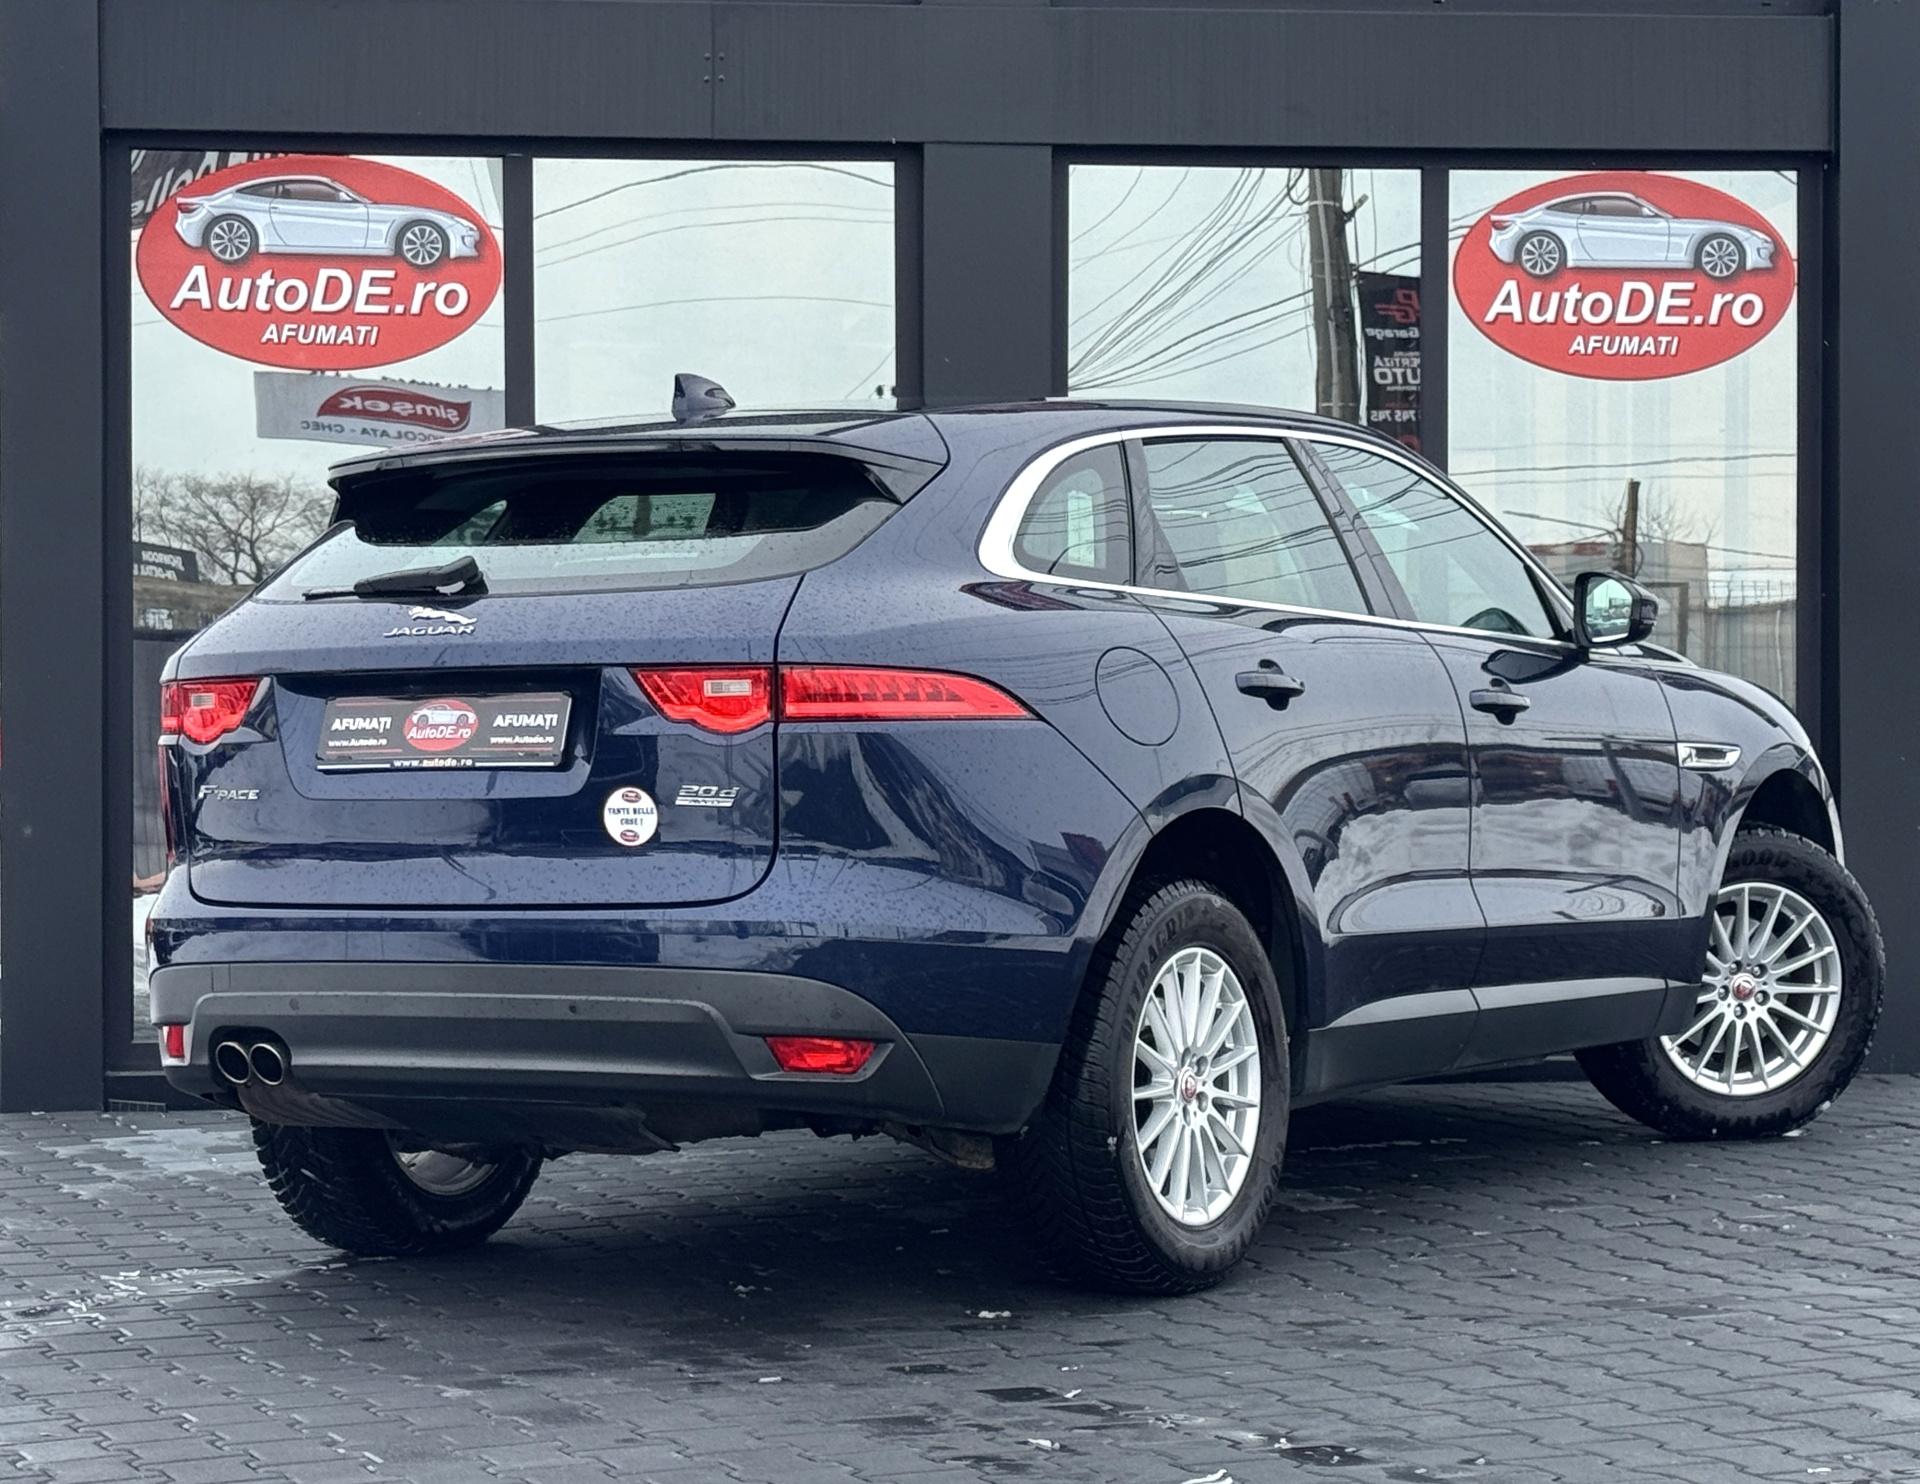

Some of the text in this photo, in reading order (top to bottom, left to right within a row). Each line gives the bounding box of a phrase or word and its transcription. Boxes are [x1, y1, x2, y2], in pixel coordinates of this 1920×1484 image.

[170, 265, 471, 317] AutoDE.ro
[1484, 279, 1765, 327] AutoDE.ro
[261, 323, 379, 346] AFUMATI
[1568, 335, 1679, 356] AFUMATI
[383, 625, 476, 638] JAGUAR
